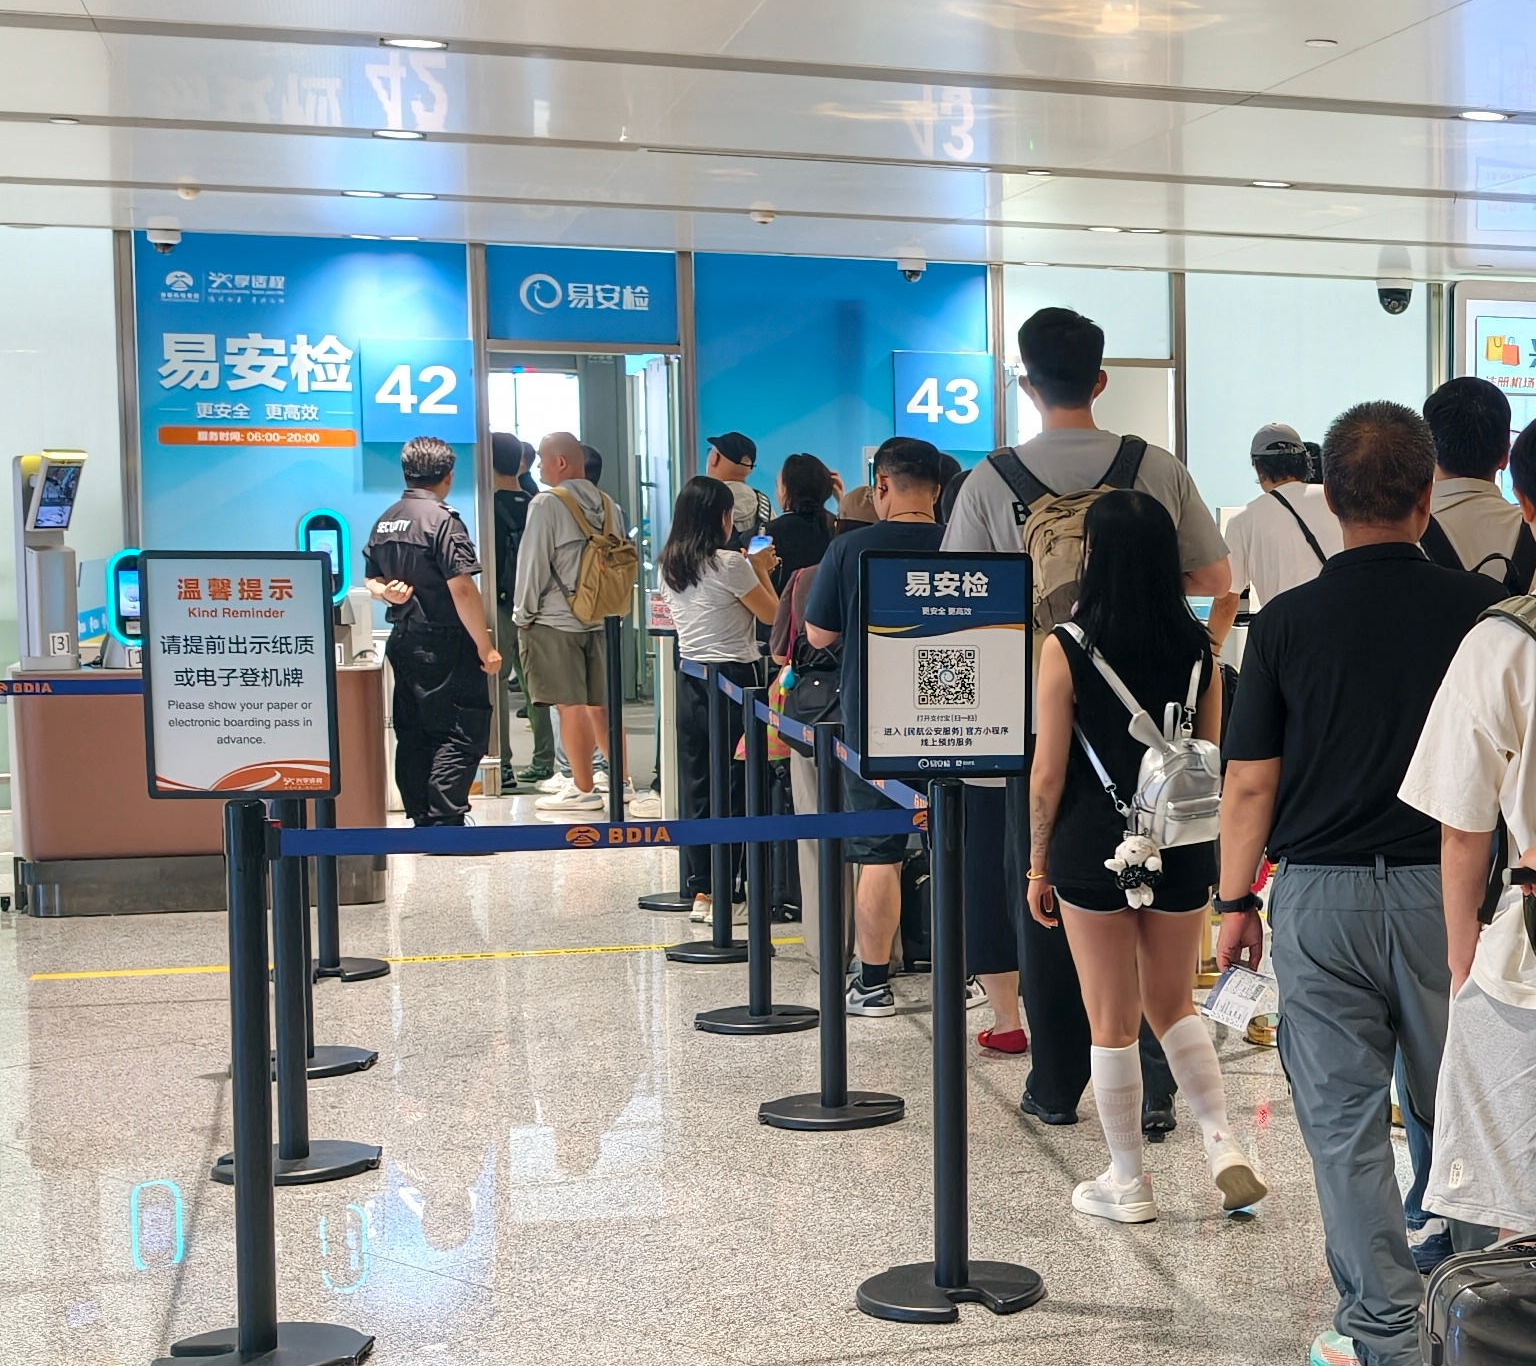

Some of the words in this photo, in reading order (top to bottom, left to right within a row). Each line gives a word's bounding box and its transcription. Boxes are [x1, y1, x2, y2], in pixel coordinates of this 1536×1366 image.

[568, 283, 650, 311] 易安检
[157, 332, 354, 393] 易安检
[375, 364, 458, 415] 42
[906, 377, 980, 425] 43
[197, 403, 251, 420] 更安全
[265, 404, 319, 421] 更高效
[177, 578, 293, 601] 温馨提示
[904, 571, 989, 598] 易安检
[188, 607, 218, 618] Kind
[222, 607, 285, 618] Reminder
[922, 606, 947, 616] 更安全
[948, 607, 973, 617] 更高效
[159, 634, 315, 655] 请提前出示纸质
[173, 667, 304, 687] 或电子登机牌
[167, 700, 205, 710] Please
[208, 700, 237, 710] show
[240, 701, 264, 711] your
[267, 701, 298, 711] paper
[301, 701, 312, 710] or
[168, 718, 221, 727] electronic
[223, 718, 271, 729] boarding
[274, 719, 300, 728] pass
[303, 717, 313, 727] in
[884, 727, 902, 736] 进入
[965, 726, 1009, 736] 官方小程序
[216, 735, 266, 745] advance.
[920, 738, 974, 747] 线上预约服务
[608, 826, 671, 844] BDIA
